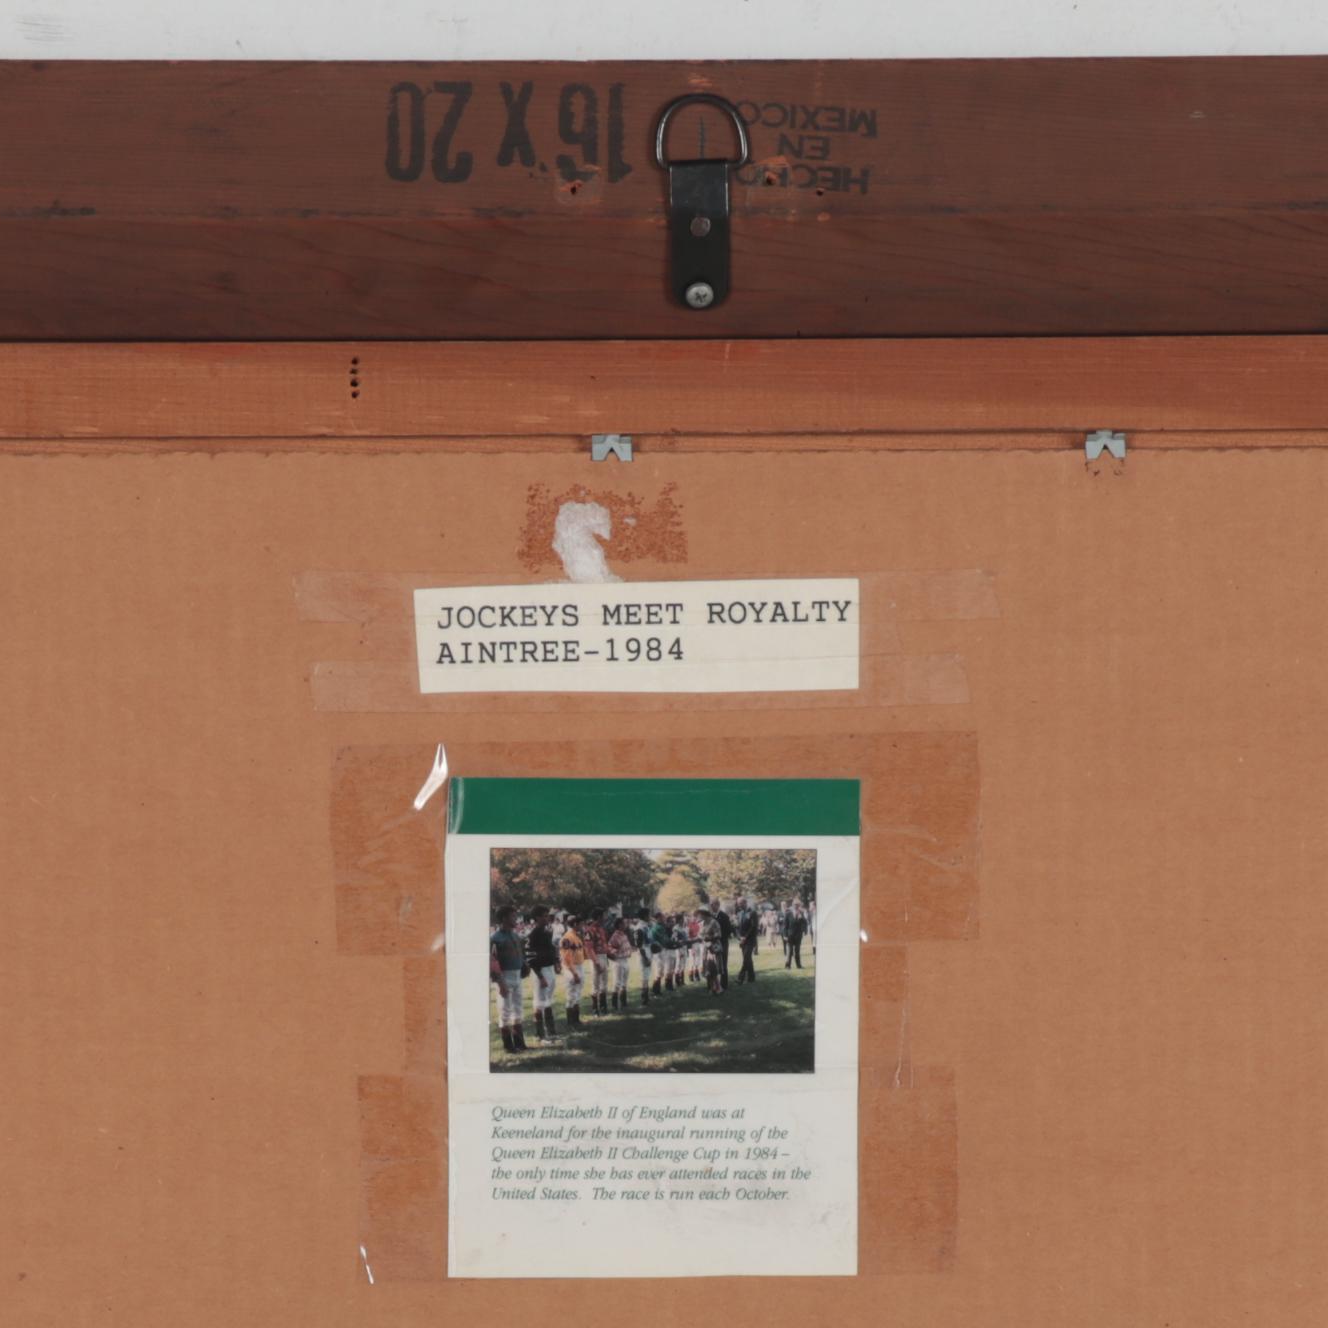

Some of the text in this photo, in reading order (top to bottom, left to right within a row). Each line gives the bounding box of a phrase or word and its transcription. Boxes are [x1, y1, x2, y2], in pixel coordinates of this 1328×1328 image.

[384, 80, 473, 183] 20
[556, 82, 632, 184] 16
[737, 101, 878, 139] MEXICO
[778, 133, 831, 161] EN
[436, 599, 853, 630] JOCKEYS MEET ROYALTY
[435, 636, 685, 665] AINTREE-1984
[490, 1104, 746, 1124] Queen Elizabeth II of England was at
[490, 1125, 789, 1144] Keeneland for the inaugural running of the
[490, 1145, 537, 1164] Queen
[539, 1145, 604, 1161] Elizabeth
[606, 1145, 619, 1160] II
[621, 1145, 690, 1164] Challenge
[692, 1146, 721, 1165] Cup
[724, 1147, 740, 1160] in
[490, 1165, 812, 1184] the only time she has ever attended races in the
[491, 1184, 790, 1201] United States. The race is run each October.
